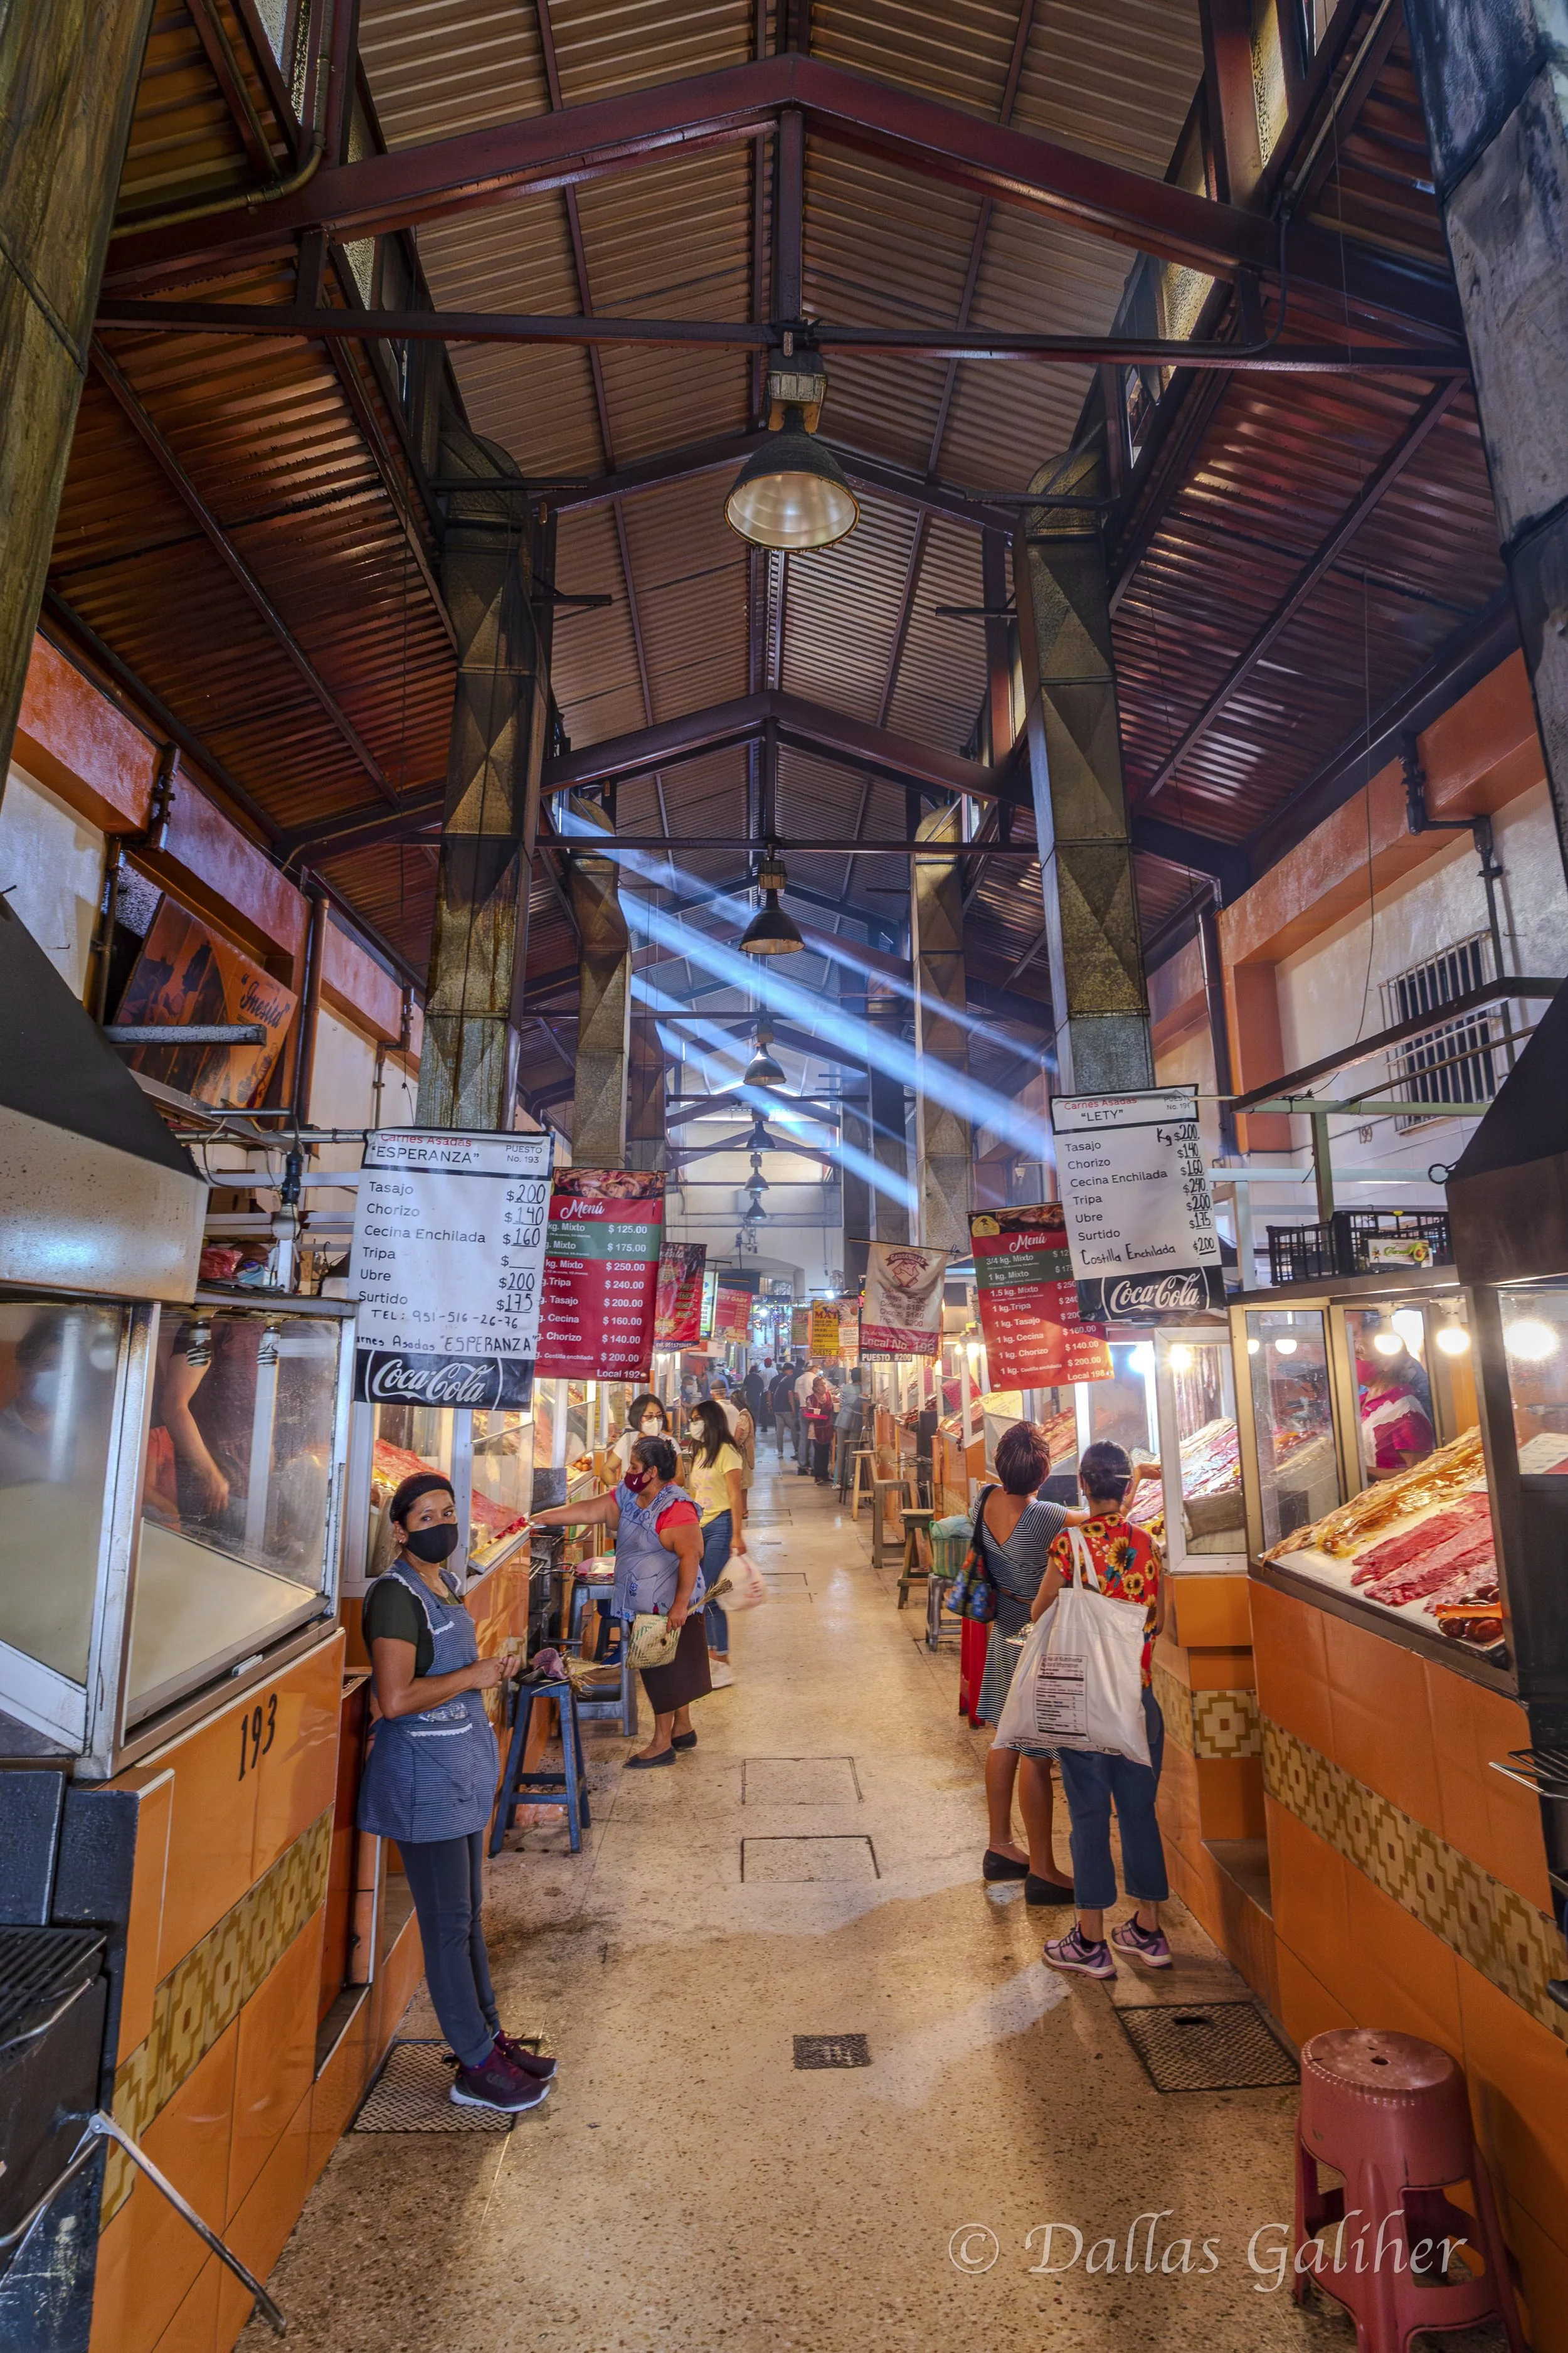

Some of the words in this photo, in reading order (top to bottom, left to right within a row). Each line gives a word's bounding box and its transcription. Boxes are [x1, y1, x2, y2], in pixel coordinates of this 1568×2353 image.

[1064, 1101, 1099, 1110] Carnes
[1101, 1098, 1137, 1107] Asadas
[381, 1134, 423, 1144] Carnes
[427, 1137, 472, 1147] Asadas
[1065, 1141, 1101, 1153] Tasajo
[1157, 1127, 1172, 1147] Kg
[506, 1145, 543, 1154] PUESTO
[524, 1155, 539, 1164] 193
[1067, 1159, 1111, 1170] Chorizo
[1071, 1176, 1109, 1187] Cecina
[1112, 1170, 1168, 1183] Enchilada
[369, 1181, 413, 1196] Tasajo
[506, 1184, 546, 1203] $200
[1073, 1194, 1103, 1205] Tripa
[367, 1203, 420, 1217] Chorizo
[504, 1206, 544, 1224] $140
[560, 1199, 605, 1219] Menú
[1075, 1213, 1103, 1223] Ubre
[364, 1225, 410, 1238] Cecina
[416, 1228, 485, 1243] Enchilada
[502, 1228, 540, 1246] $160
[561, 1223, 585, 1231] Mixto
[608, 1224, 615, 1235] $
[617, 1226, 647, 1234] 125.00
[1078, 1229, 1120, 1241] Surtido
[553, 1240, 576, 1250] Mixto
[607, 1243, 613, 1252] $
[616, 1243, 647, 1252] 175.00
[1009, 1233, 1047, 1253] Menú
[363, 1246, 396, 1260] Tripa
[986, 1256, 998, 1265] 3/4
[999, 1256, 1011, 1265] kg.
[1013, 1254, 1034, 1263] Mixto
[1080, 1248, 1121, 1265] Costilla
[1125, 1243, 1176, 1260] Enchilada
[559, 1260, 583, 1269] Mixto
[606, 1261, 612, 1272] $
[614, 1263, 645, 1272] 250.00
[360, 1269, 391, 1281] Ubre
[499, 1272, 534, 1290] $200
[995, 1272, 1006, 1280] kg.
[1009, 1270, 1029, 1279] Mixto
[541, 1277, 571, 1287] g.Tripa
[605, 1280, 611, 1290] $
[613, 1280, 644, 1289] 240.00
[1004, 1288, 1016, 1297] kg.
[1018, 1286, 1039, 1294] Mixto
[1110, 1273, 1201, 1313] Coca-Cola
[359, 1290, 408, 1304] Surtido
[497, 1293, 533, 1312] $175
[549, 1295, 578, 1306] Tasajo
[603, 1298, 610, 1308] $
[612, 1299, 643, 1307] 200.00
[371, 1309, 405, 1320] TEL:
[548, 1314, 580, 1323] Cecina
[603, 1316, 609, 1325] $
[612, 1317, 642, 1325] 160.00
[1001, 1319, 1012, 1328] kg.
[1014, 1317, 1041, 1326] Tasajo
[546, 1332, 582, 1342] Chorizo
[601, 1334, 608, 1344] $
[610, 1335, 640, 1344] 140.00
[1003, 1336, 1014, 1344] kg.
[1016, 1332, 1044, 1341] Cecina
[1069, 1325, 1096, 1334] 160.00
[393, 1335, 435, 1351] Asadas
[862, 1335, 889, 1348] Local
[891, 1339, 909, 1350] No.
[1005, 1351, 1017, 1359] kg.
[1019, 1348, 1049, 1357] Chorizo
[1072, 1341, 1099, 1350] 140.00
[601, 1352, 607, 1362] $
[608, 1353, 639, 1362] 200.00
[862, 1353, 890, 1361] PUESTO
[1007, 1367, 1019, 1375] kg.
[1074, 1356, 1101, 1366] 200.00
[596, 1369, 621, 1378] Local
[623, 1369, 640, 1378] 192
[1067, 1371, 1089, 1381] Local
[372, 1359, 495, 1402] Coca-Cola
[238, 1693, 278, 1782] 193
